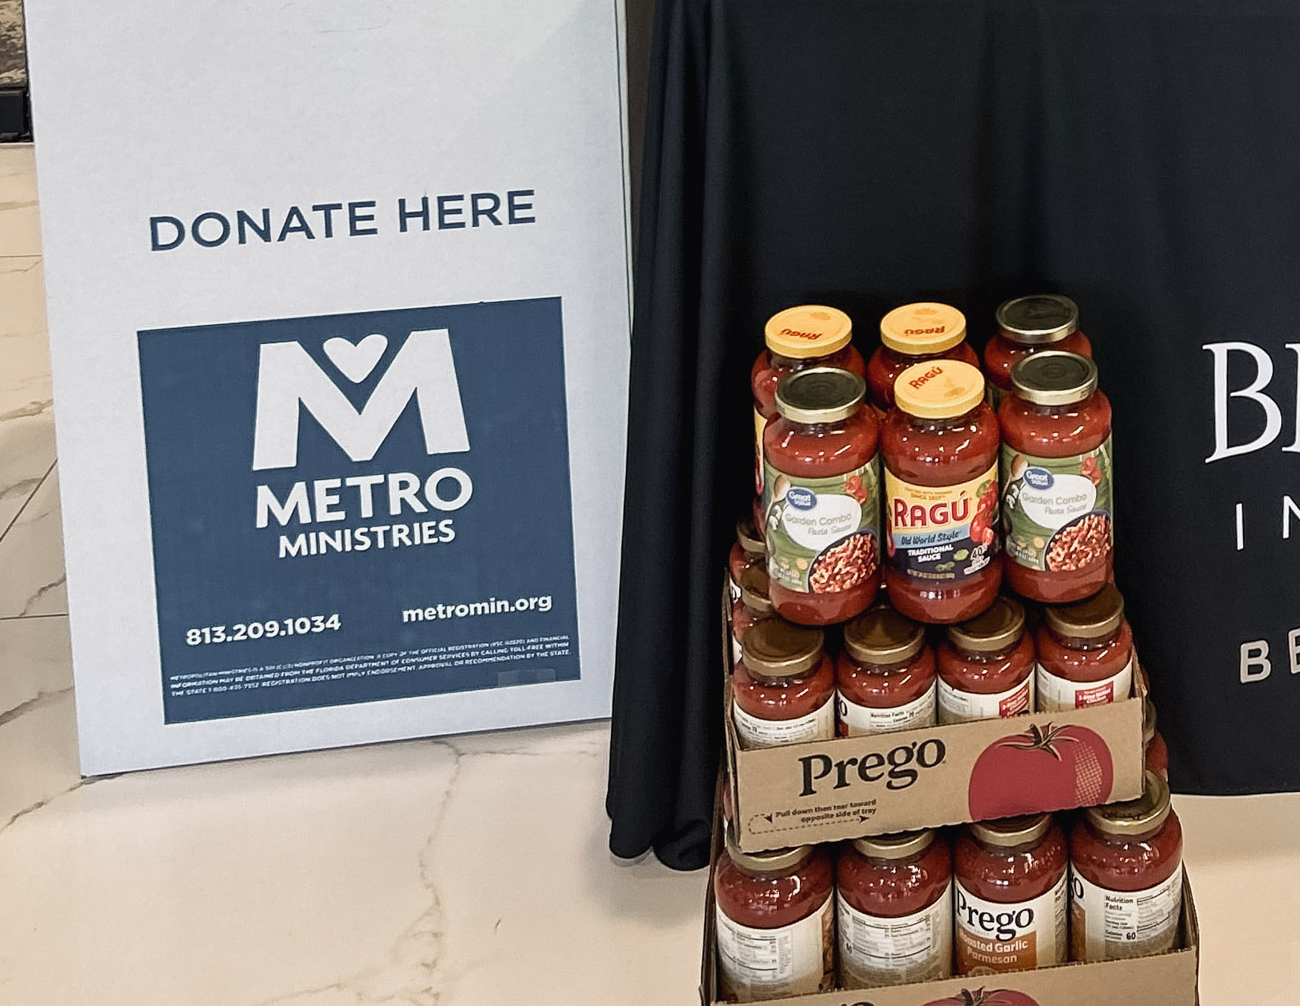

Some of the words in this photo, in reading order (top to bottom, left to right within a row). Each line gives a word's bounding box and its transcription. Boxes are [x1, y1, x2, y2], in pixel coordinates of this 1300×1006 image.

[149, 200, 378, 252] DONATE
[398, 189, 536, 233] HERE
[255, 467, 473, 529] METRO
[893, 490, 970, 527] RAGÚ
[784, 513, 817, 526] Garden
[820, 513, 852, 524] Combo
[278, 519, 456, 559] MINISTRIES
[901, 536, 915, 545] Old
[916, 533, 937, 545] World
[938, 530, 961, 542] Style
[907, 544, 954, 557] TRADITIONAL
[917, 553, 941, 562] SAUCE
[402, 595, 553, 624] metromin.org
[185, 614, 342, 646] 813.209.1034
[799, 738, 946, 797] Prego
[776, 809, 790, 818] Pull
[791, 807, 813, 815] down
[815, 805, 832, 813] then
[850, 799, 877, 809] toward
[801, 812, 834, 824] opposite
[861, 807, 877, 816] tray
[955, 888, 1034, 942] Prego
[967, 949, 1017, 964] Parmesan
[994, 940, 1029, 954] Garlic
